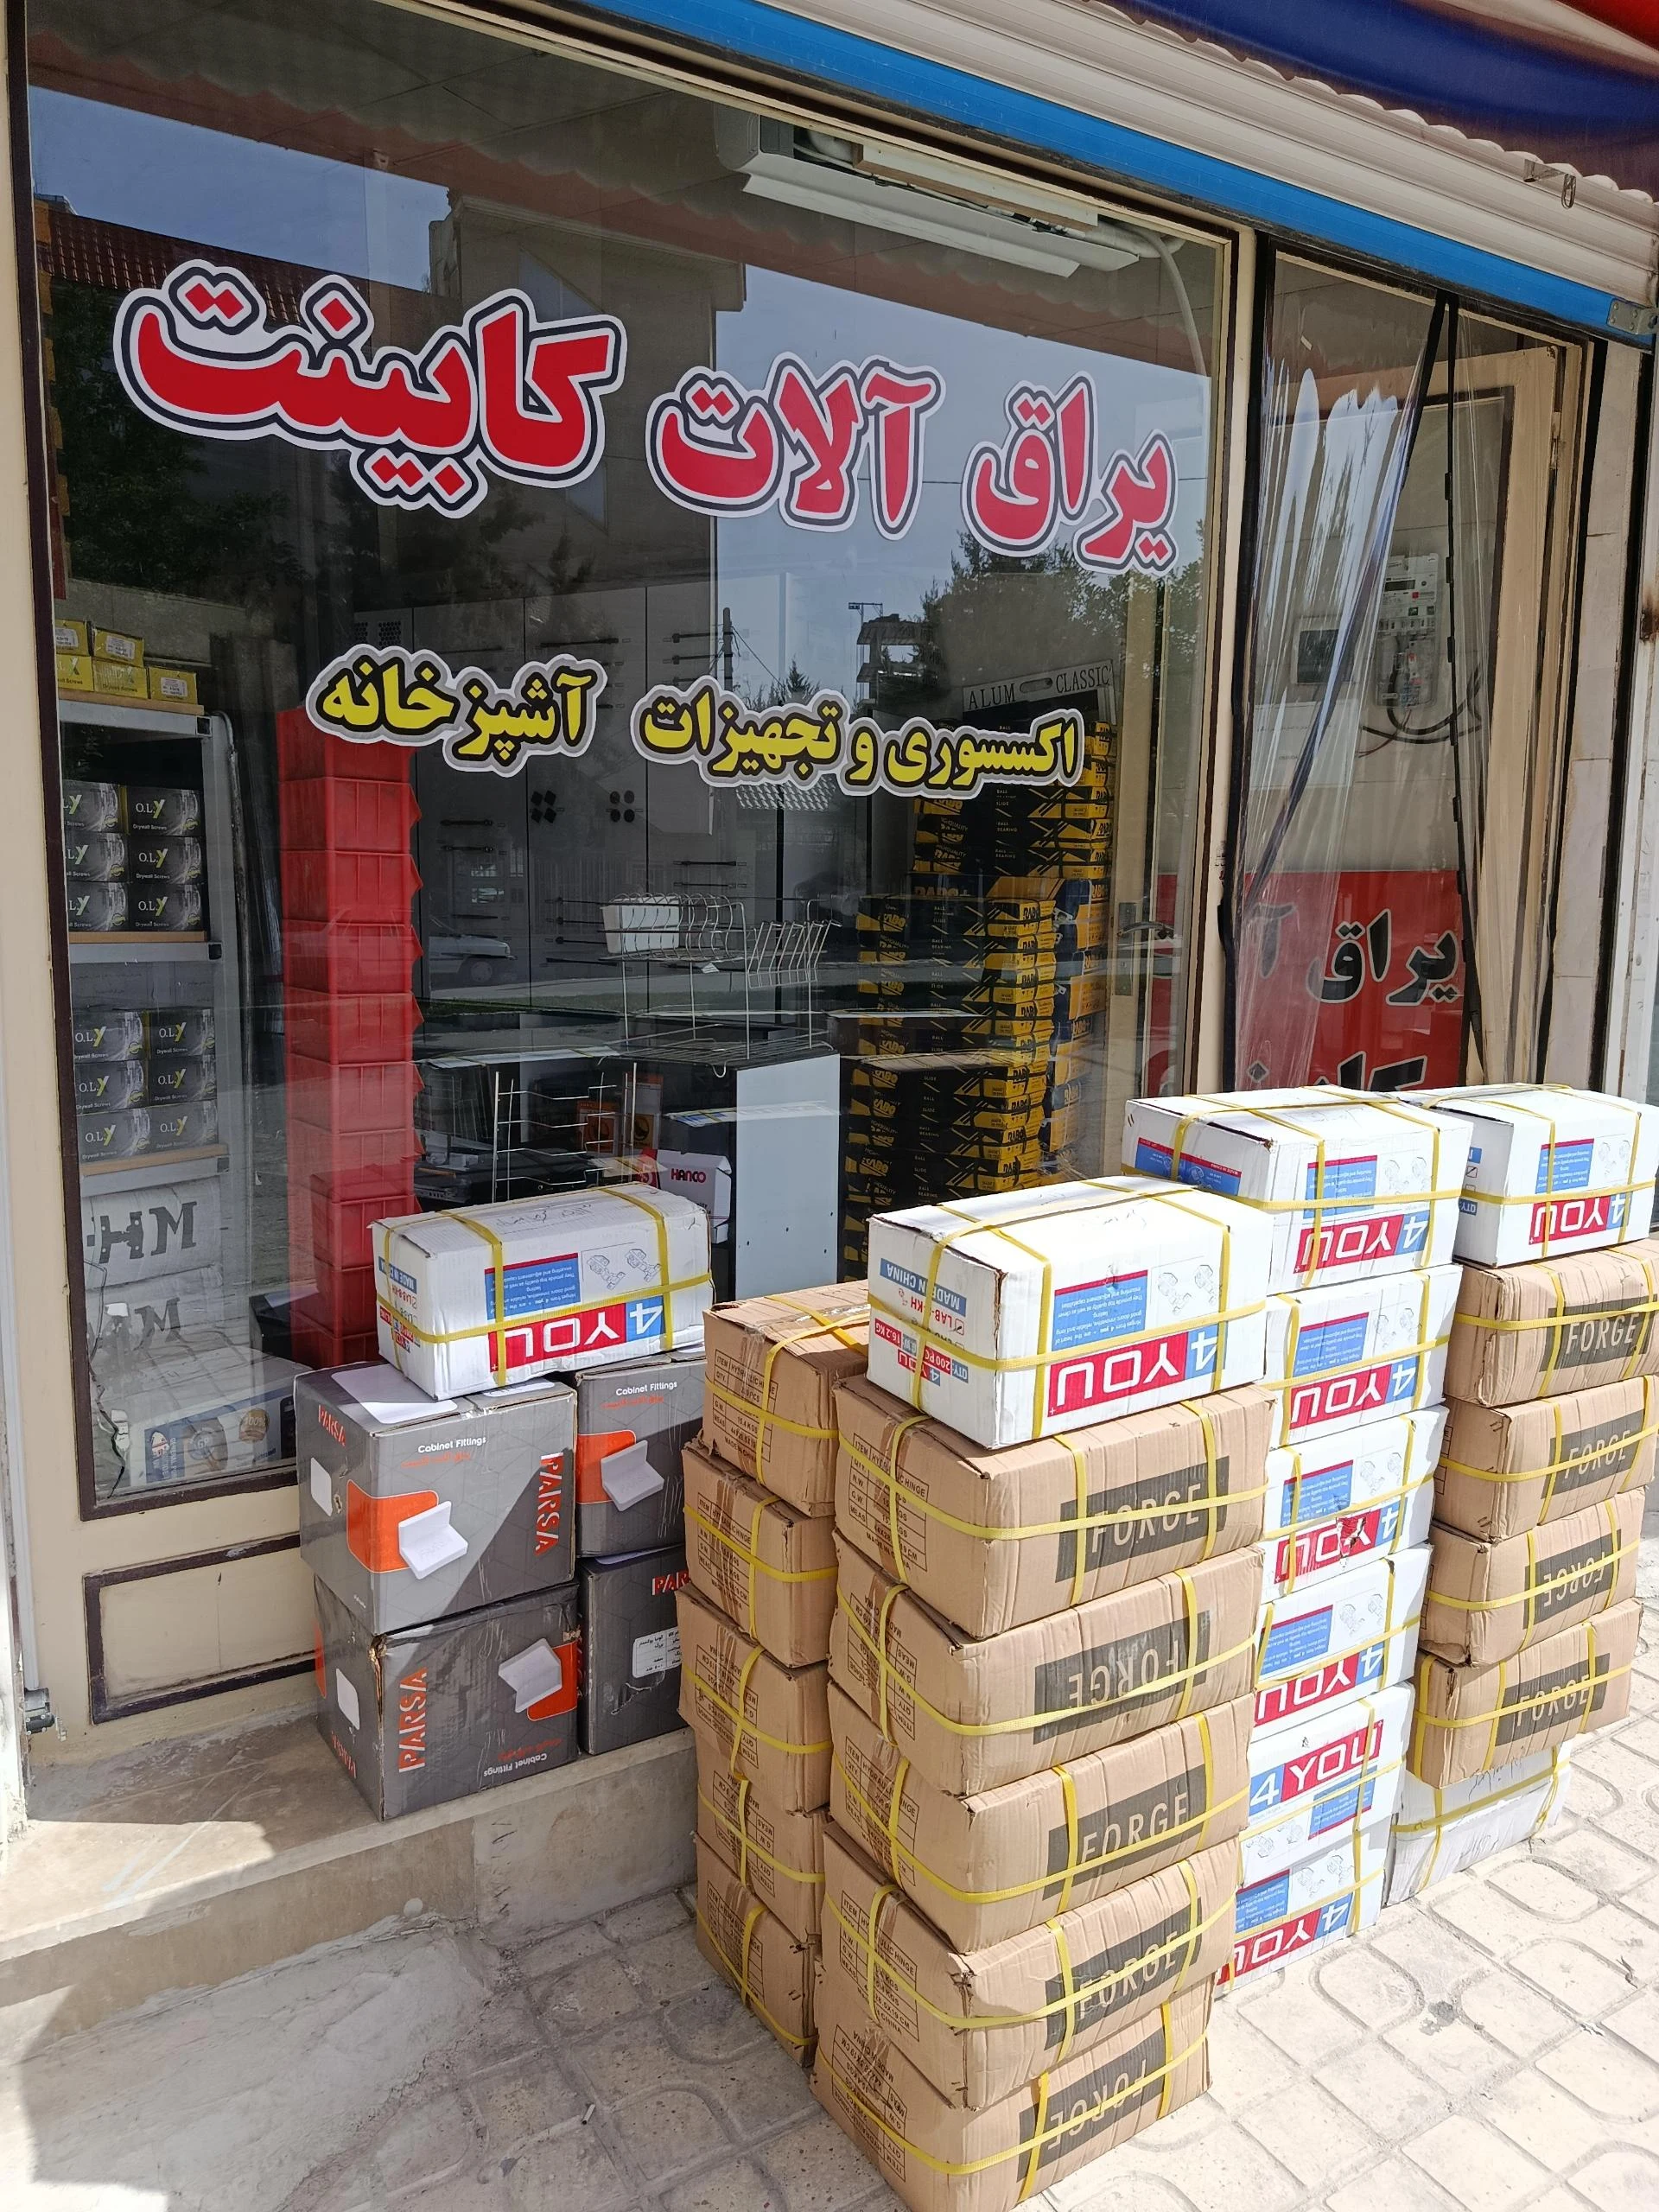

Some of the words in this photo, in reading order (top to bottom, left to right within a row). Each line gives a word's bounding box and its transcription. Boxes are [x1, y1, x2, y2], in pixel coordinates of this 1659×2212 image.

[113, 259, 626, 518] کابینت
[645, 352, 945, 540] آلات
[962, 370, 1179, 575] یراق
[969, 683, 1016, 709] ALUM
[1056, 665, 1112, 693] CLASSIC
[631, 675, 850, 787] تجهیزات
[881, 709, 1084, 798] اکسسوری
[841, 715, 882, 796] و
[1307, 908, 1463, 1006] یراق
[1305, 1221, 1392, 1264] YOU
[1402, 1213, 1428, 1242] 4
[887, 1263, 916, 1288] CHINA
[505, 1309, 620, 1359] YOU
[629, 1302, 664, 1335] 4
[876, 1322, 886, 1334] KG
[886, 1328, 900, 1344] 16.2
[1566, 1312, 1637, 1355] FORGE
[716, 1355, 728, 1369] ITEM
[936, 1355, 950, 1371] 200
[1190, 1332, 1217, 1372] 4
[616, 1384, 648, 1396] Cabinet
[650, 1382, 677, 1391] Fittings
[1057, 1343, 1180, 1408] YOU
[1293, 1370, 1382, 1414] YOU
[1392, 1363, 1415, 1388] 4
[418, 1441, 454, 1453] Cabinet
[455, 1437, 486, 1448] Fittings
[1566, 1427, 1630, 1478] FORGE
[855, 1440, 868, 1456] ITEM
[905, 1477, 926, 1498] HINGE
[535, 1452, 565, 1555] PARSA
[699, 1498, 710, 1512] ITEM
[735, 1529, 752, 1545] HINGE
[1088, 1479, 1203, 1555] FORGE
[1380, 1510, 1401, 1541] 4
[652, 1569, 690, 1597] PAR
[1542, 1549, 1611, 1607] FORGE
[1068, 1636, 1179, 1713] FORGE
[1361, 1648, 1383, 1676] 4
[1258, 1662, 1358, 1720] YOU
[1516, 1673, 1590, 1728] FORGE
[398, 1667, 428, 1772] PARSA
[484, 1763, 512, 1777] Fittings
[515, 1752, 547, 1769] Cabinet
[848, 1745, 861, 1764] ITEM
[1251, 1774, 1281, 1807] 4
[1287, 1723, 1379, 1792] YOU
[1078, 1787, 1191, 1862] FORGE
[1320, 1899, 1350, 1928] 4
[843, 1898, 858, 1918] ITEM
[894, 1951, 915, 1976] HINGE
[1075, 1924, 1181, 2013] FORGE
[899, 2016, 910, 2031] CM
[1046, 2061, 1148, 2162] FORGE
[887, 2156, 902, 2175] ITEM
